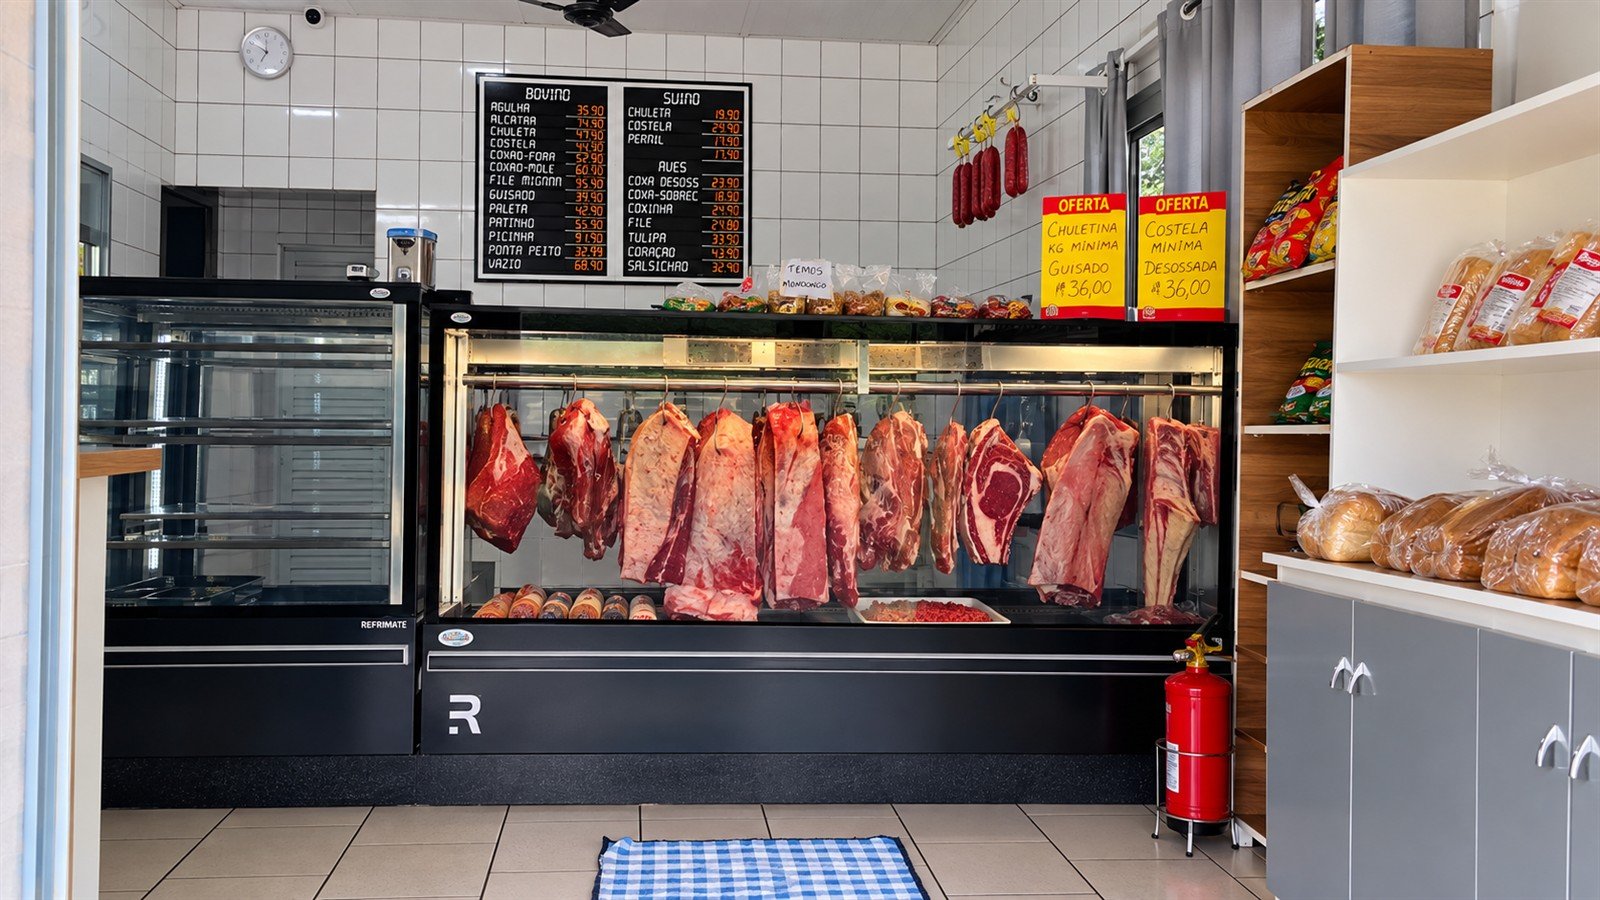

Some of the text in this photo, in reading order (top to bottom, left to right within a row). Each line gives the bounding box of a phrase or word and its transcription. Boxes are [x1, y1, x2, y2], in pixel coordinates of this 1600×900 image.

[525, 87, 571, 101] BOVINO
[663, 92, 700, 106] SUINO
[490, 101, 530, 113] AGULHA
[628, 106, 740, 121] CHULETA 19.90
[490, 126, 536, 138] CHULETA
[628, 120, 672, 132] COSTELA
[490, 138, 536, 149] COSTELA
[627, 133, 664, 145] PERNIL
[489, 162, 555, 174] COXAO-MOLE
[658, 161, 687, 173] AVES
[489, 174, 515, 186] FILE
[628, 175, 740, 189] COXA DESOSS 23.90
[489, 189, 535, 201] GUISADO
[627, 189, 740, 202] COXA-SOBREC 18.90
[489, 203, 528, 214] PALETA
[627, 203, 673, 214] COXINHA
[1058, 197, 1110, 213] OFERTA
[1155, 195, 1209, 213] OFERTA
[489, 217, 534, 229] PATINHO
[627, 217, 652, 228] FILE
[1047, 221, 1118, 238] CHULETINA
[1145, 221, 1209, 238] COSTELA
[489, 231, 534, 242] PICINHA
[628, 232, 667, 243] TULIPA
[488, 245, 523, 256] PONTA
[528, 245, 562, 257] PEITO
[1048, 243, 1064, 254] KG
[488, 258, 603, 271] VAZIO 68.90
[627, 260, 689, 273] SALSICHAO
[787, 264, 823, 276] TEMOS
[1048, 260, 1109, 276] GUISADO
[1144, 260, 1217, 276] DESOSSADA
[361, 620, 407, 629] REFRIMATE
